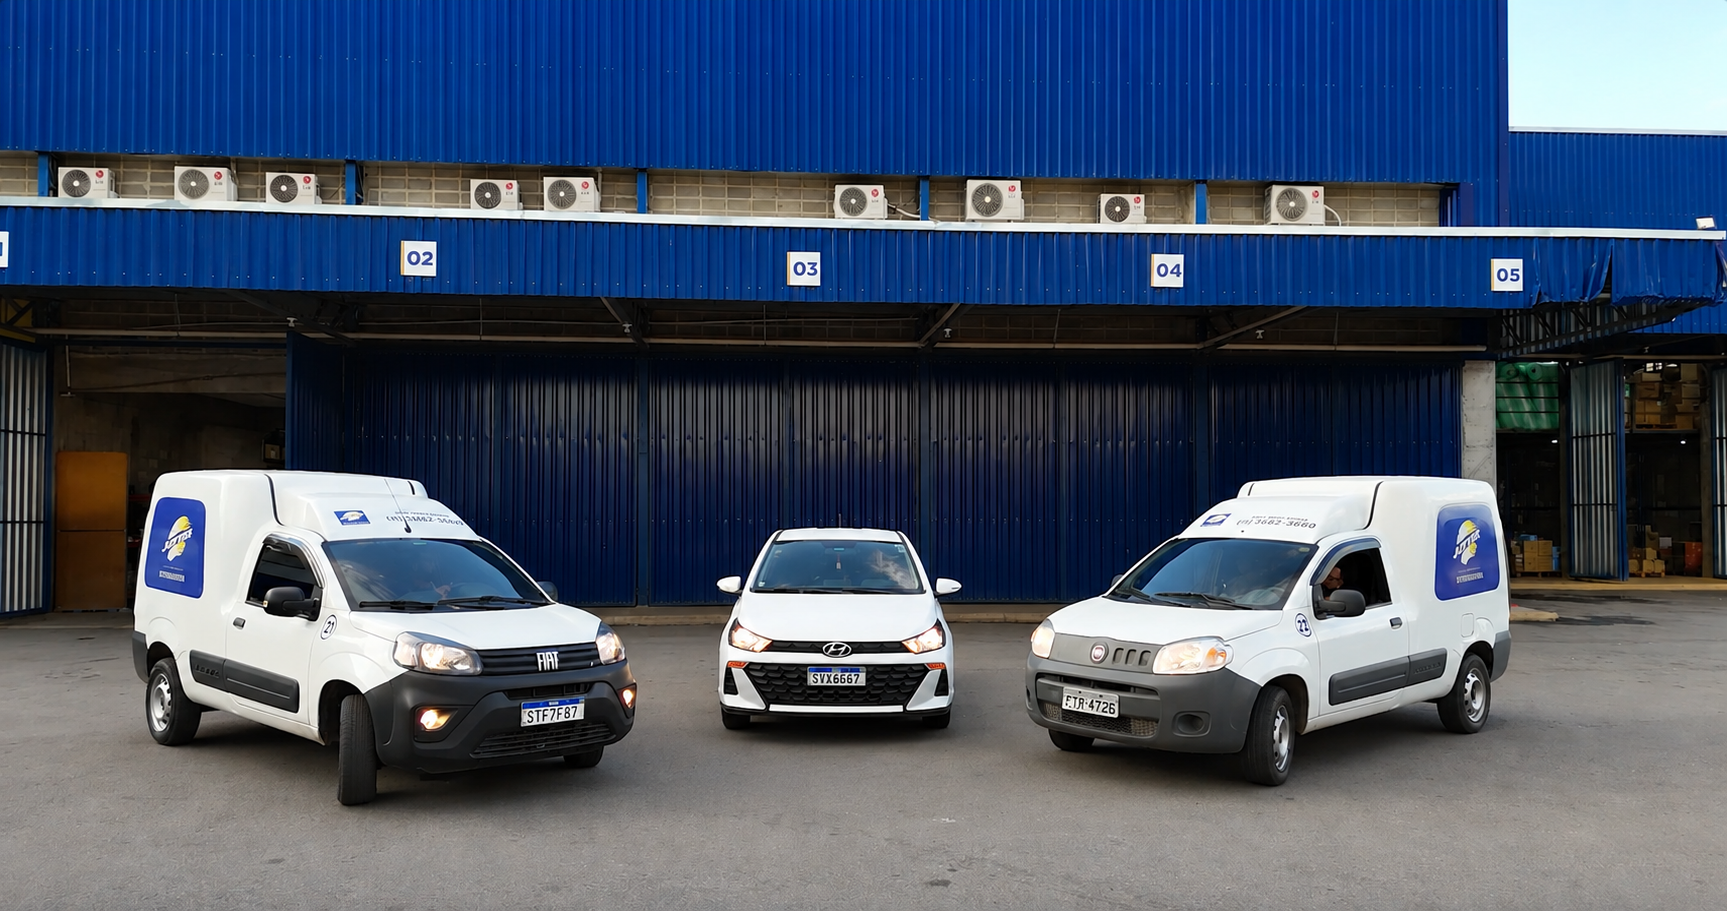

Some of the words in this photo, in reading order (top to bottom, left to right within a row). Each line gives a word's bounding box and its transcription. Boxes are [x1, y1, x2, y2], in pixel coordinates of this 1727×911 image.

[407, 250, 434, 266] 02
[793, 261, 818, 276] 03
[1156, 263, 1182, 278] 04
[1496, 267, 1521, 282] 05
[323, 620, 335, 635] 21
[536, 651, 559, 671] FIAT
[812, 673, 860, 684] SVX6667
[527, 706, 578, 723] STF7F87
